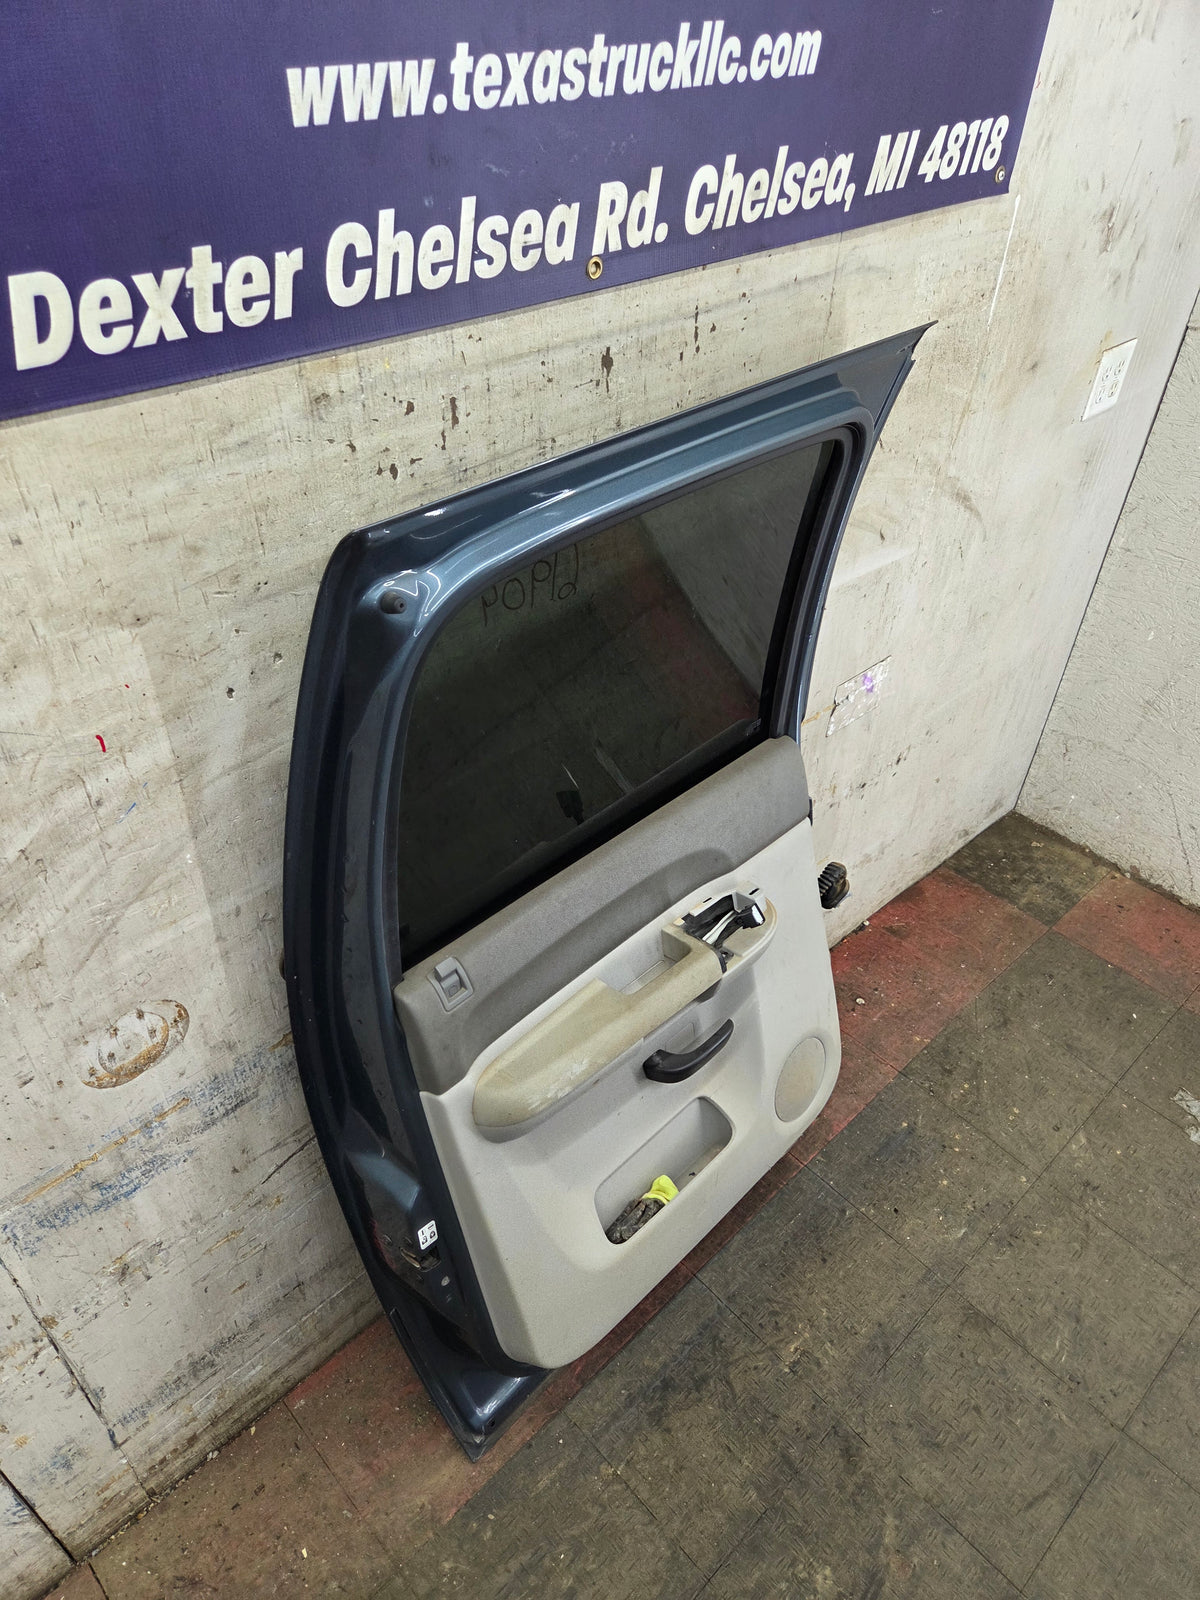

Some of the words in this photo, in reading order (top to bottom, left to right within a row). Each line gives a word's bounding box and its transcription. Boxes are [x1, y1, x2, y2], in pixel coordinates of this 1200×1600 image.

[285, 19, 823, 128] www.texastruckllc.com
[7, 243, 304, 371] Dexter
[324, 195, 581, 308] Chelsea
[592, 165, 669, 257] Rd.
[684, 145, 856, 236] Chelsea,
[864, 129, 921, 197] MI
[918, 114, 1010, 184] 48118
